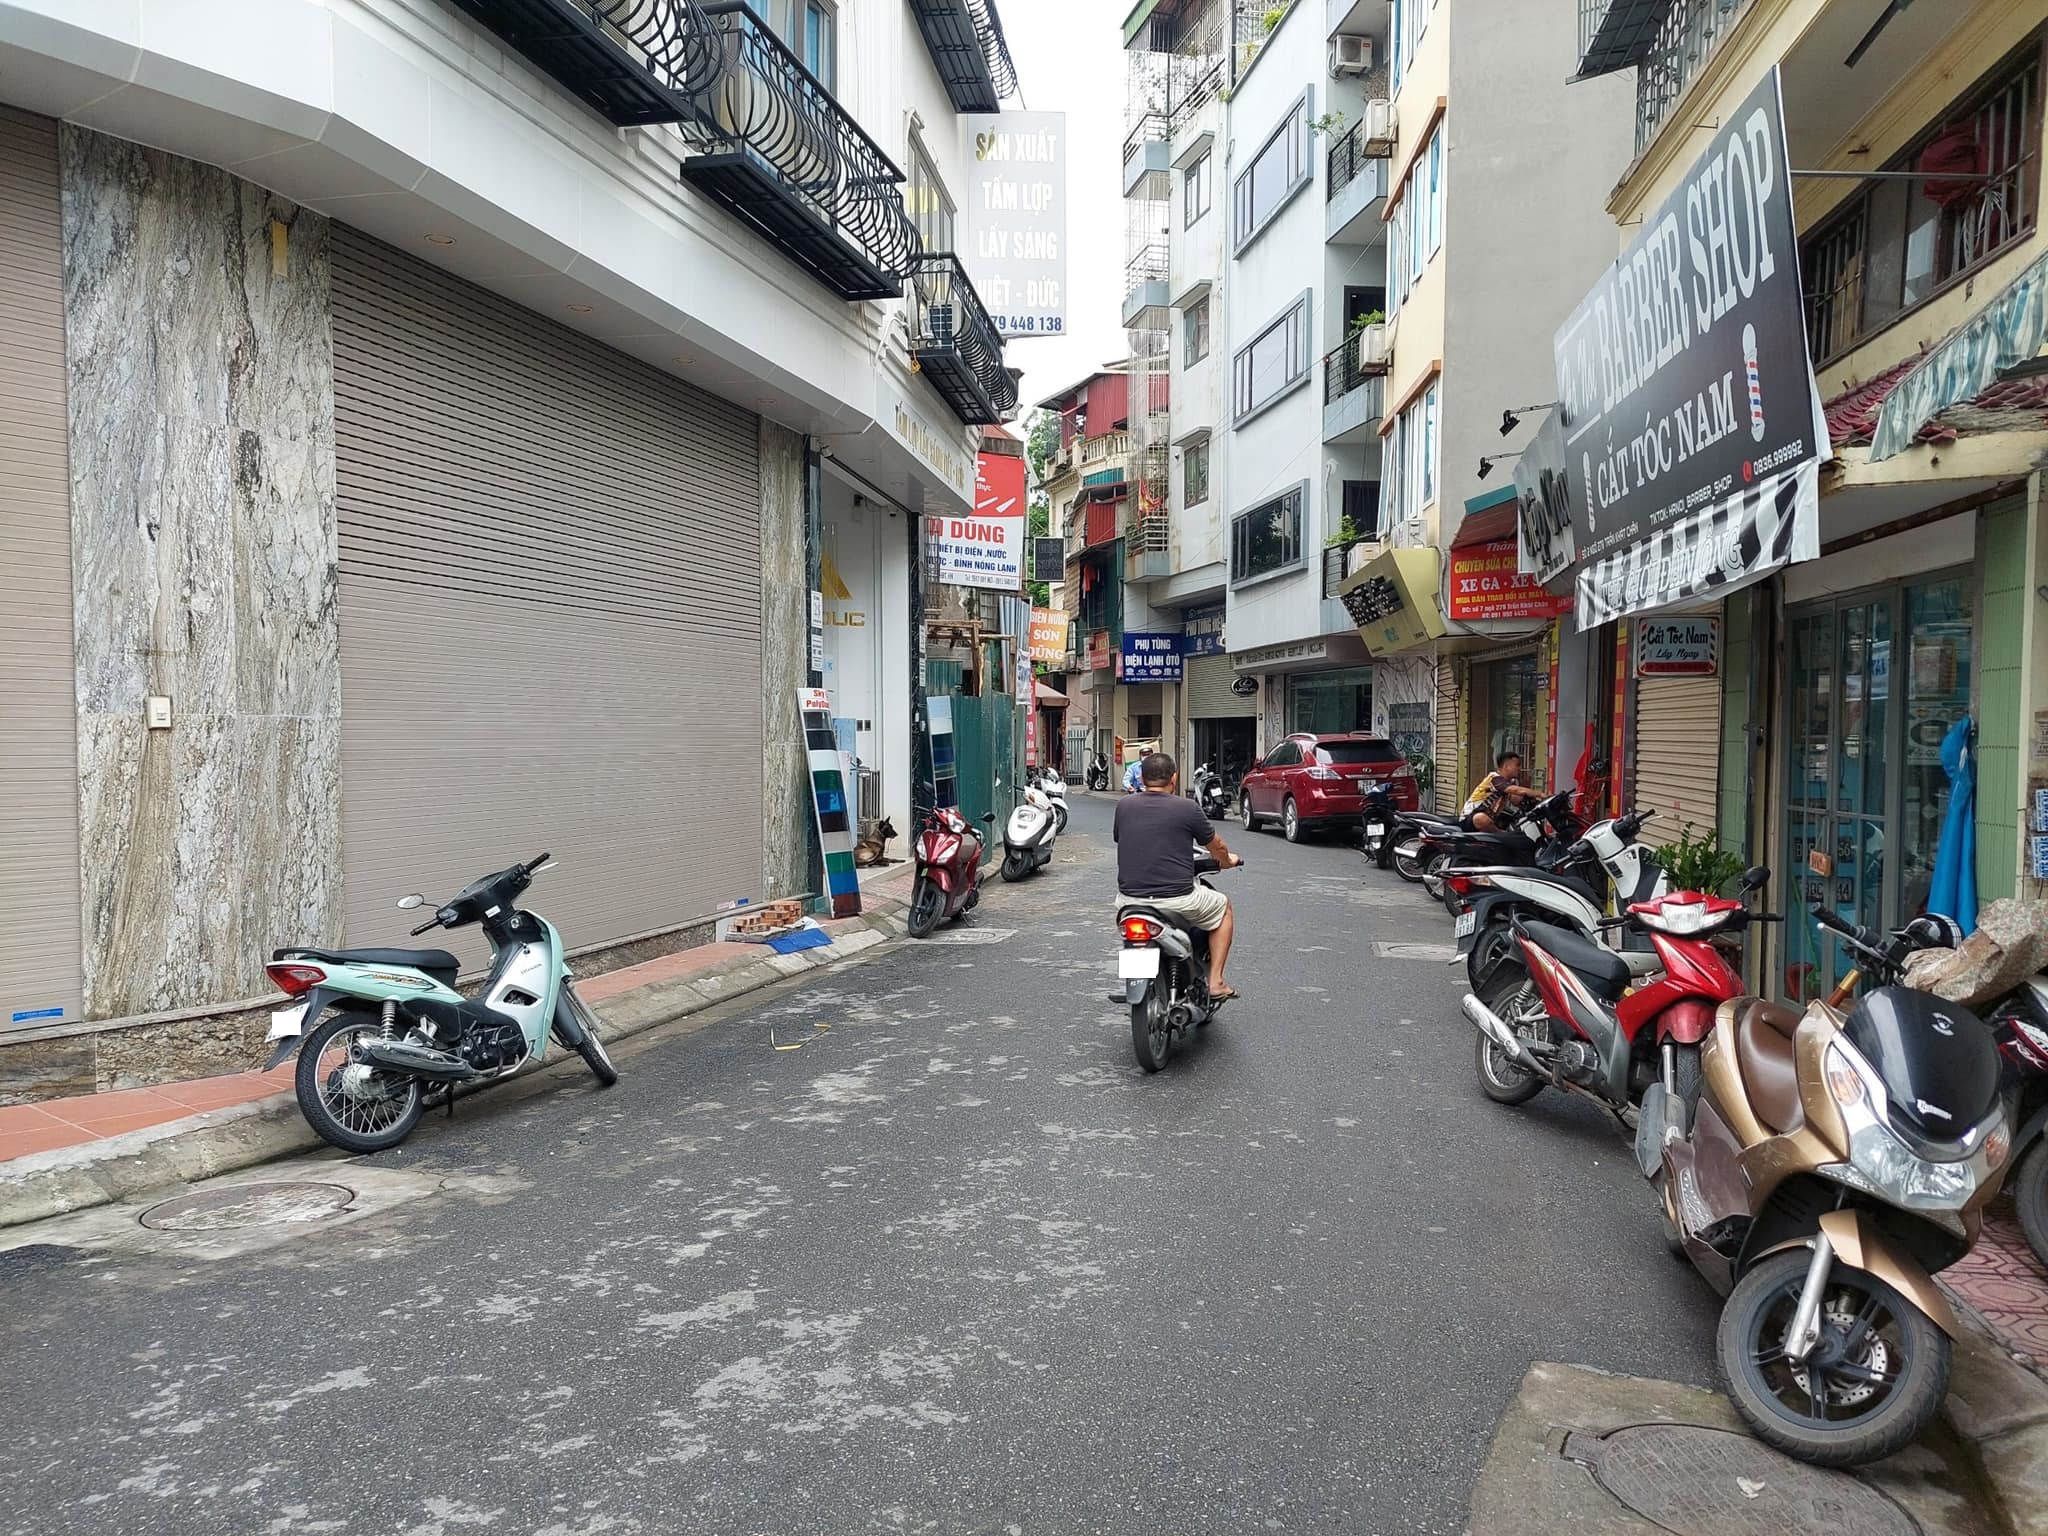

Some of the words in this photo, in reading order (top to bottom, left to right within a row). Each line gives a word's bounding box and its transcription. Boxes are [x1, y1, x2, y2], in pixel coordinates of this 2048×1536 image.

[975, 125, 1010, 162] SẢN
[1015, 127, 1056, 162] XUẤT
[982, 174, 1017, 210] TẤM
[1022, 182, 1053, 216] LỢP
[978, 222, 1008, 259] LẤY
[1013, 225, 1057, 260] SÁNG
[1594, 211, 1690, 415] BARBER
[1687, 106, 1776, 335] SHOP
[1026, 275, 1060, 308] ĐỨC
[1010, 315, 1034, 331] 448
[1039, 316, 1062, 331] 138
[1597, 423, 1630, 509] CẮT
[1631, 411, 1673, 488] TÓC
[1674, 370, 1738, 464] NAM
[950, 519, 1005, 544] DŨNG
[1460, 578, 1478, 593] XE
[1481, 576, 1501, 591] GA
[1511, 574, 1529, 589] XE
[1135, 638, 1150, 652] PHỤ
[1152, 636, 1171, 650] TÙNG
[1686, 625, 1709, 645] Nam
[1125, 653, 1142, 668] ĐIỆN
[1143, 655, 1164, 668] LẠNH
